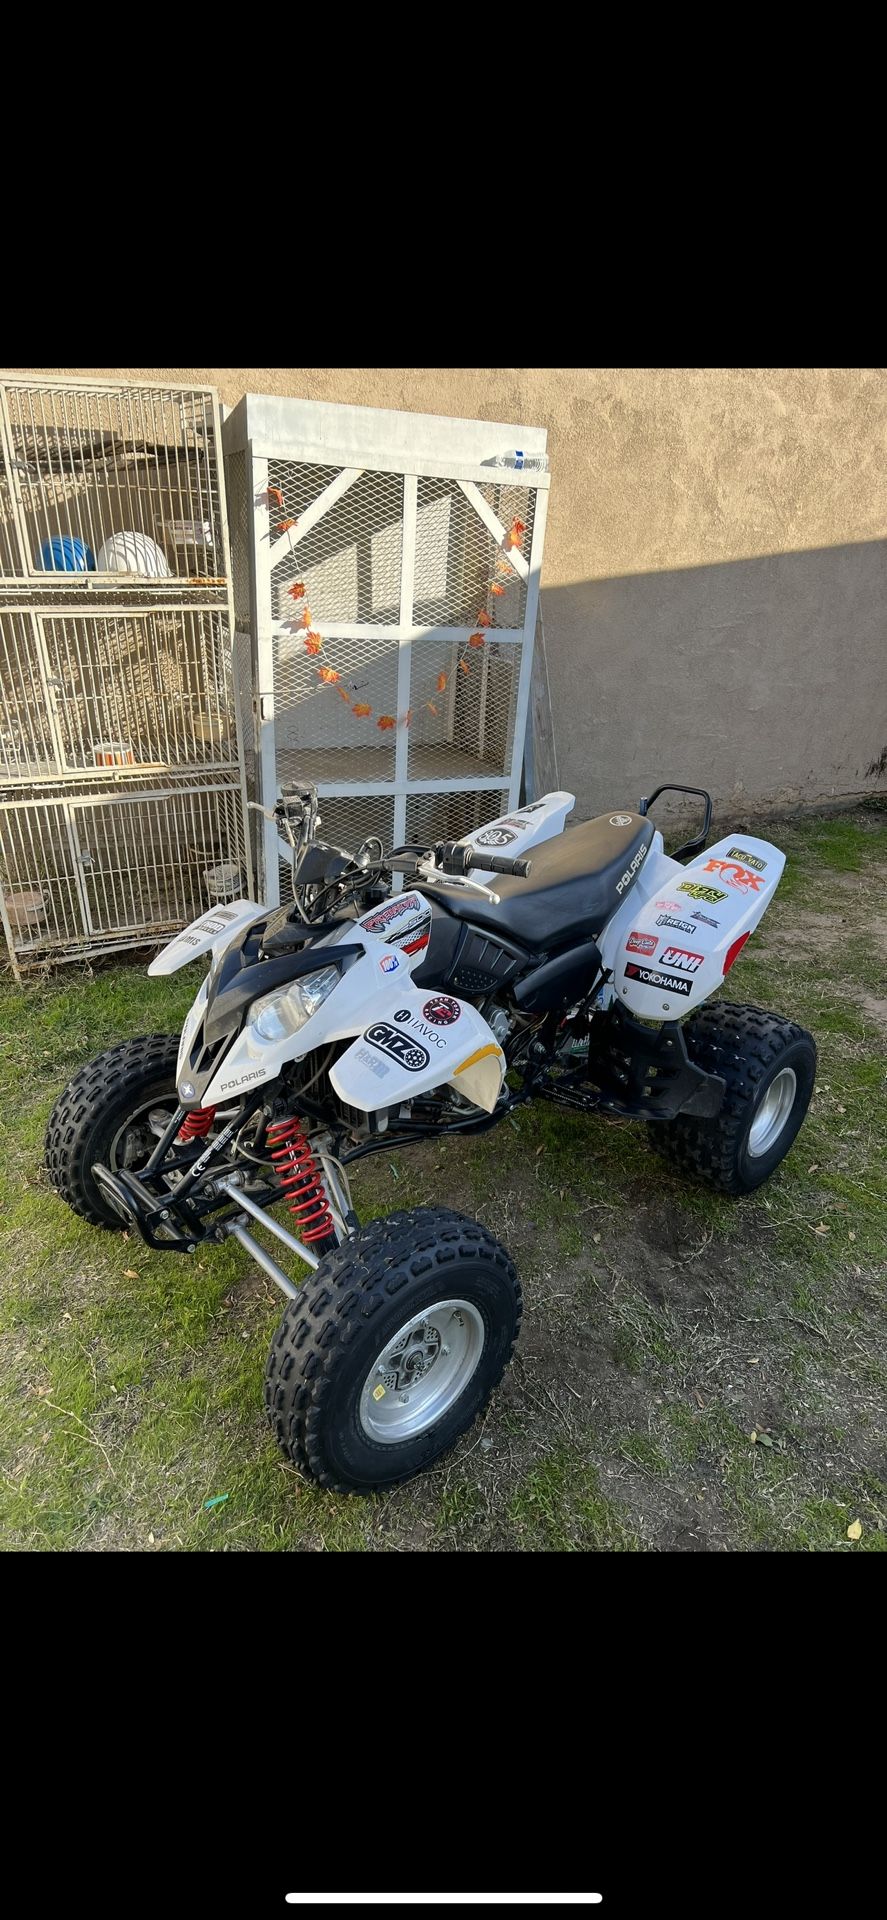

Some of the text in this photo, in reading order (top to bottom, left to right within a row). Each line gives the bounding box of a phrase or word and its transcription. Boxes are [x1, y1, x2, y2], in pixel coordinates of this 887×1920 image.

[616, 843, 647, 895] POLARIS
[703, 858, 765, 892] FOX
[666, 917, 695, 933] REIGN
[662, 949, 703, 972] UNI
[639, 969, 688, 992] YOKOHAMA
[368, 1026, 416, 1061] GMZ
[220, 1068, 266, 1092] POLARIS
